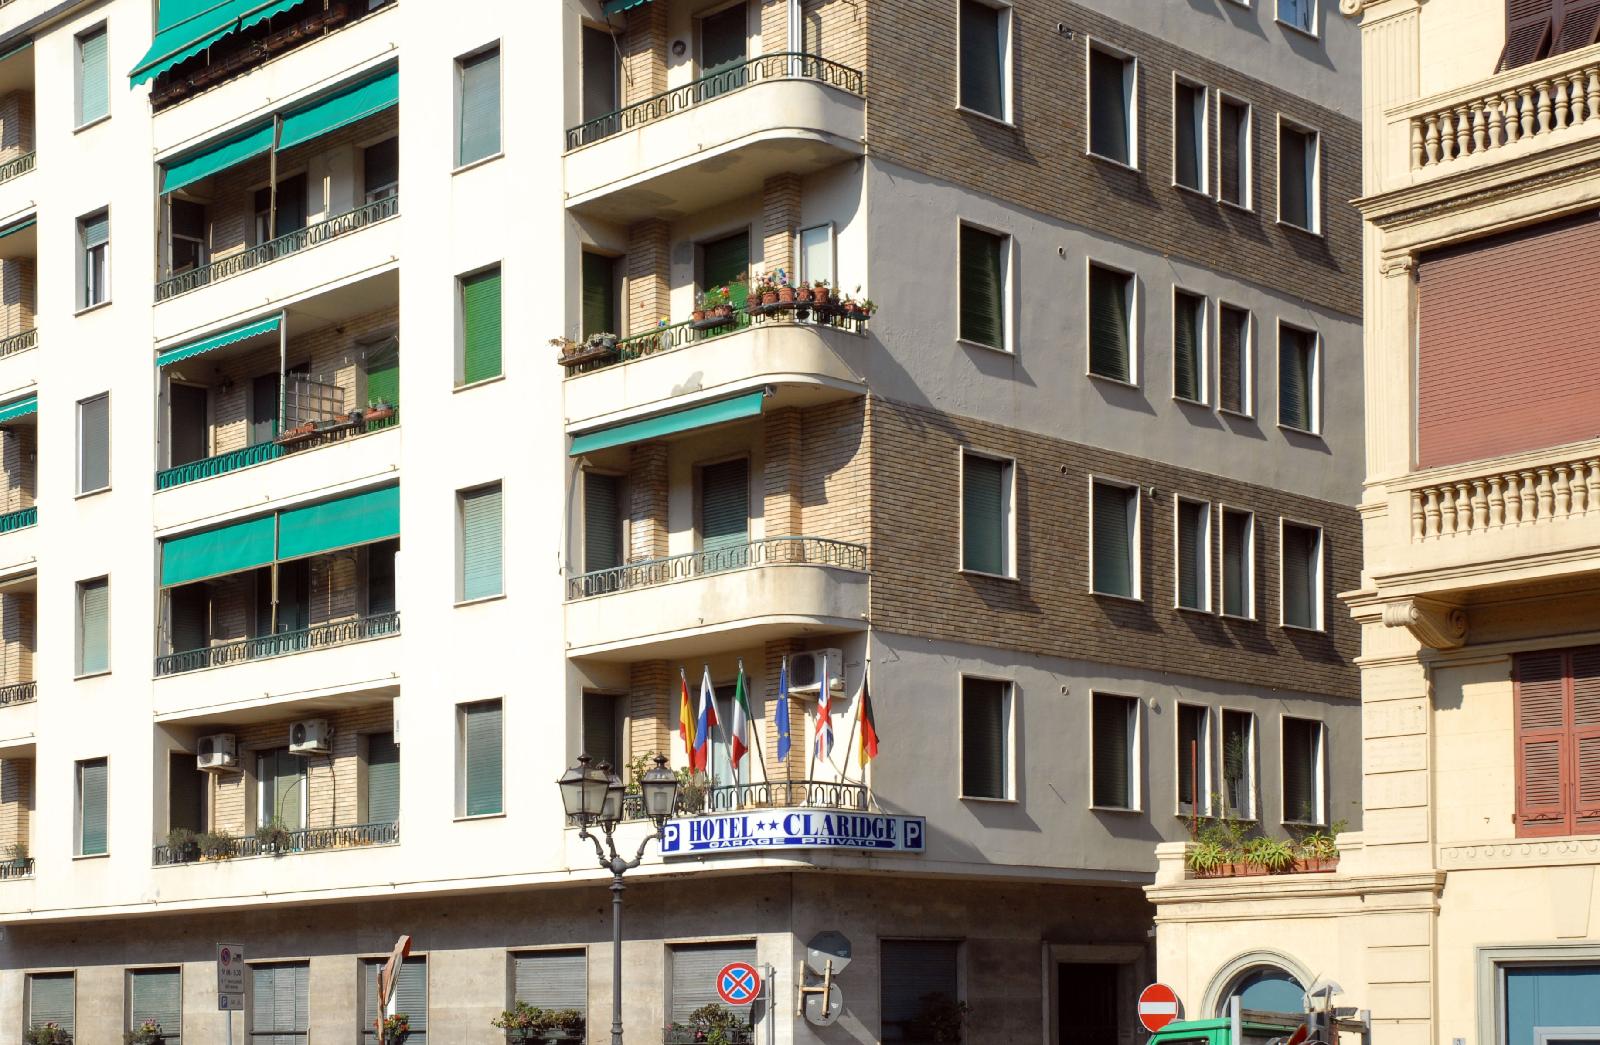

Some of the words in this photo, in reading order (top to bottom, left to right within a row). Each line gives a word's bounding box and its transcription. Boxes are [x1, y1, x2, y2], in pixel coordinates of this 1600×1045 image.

[664, 825, 678, 850] P
[688, 816, 754, 842] HOTEL
[782, 813, 896, 840] CLARIDGE
[906, 822, 920, 846] P
[709, 837, 785, 849] GARAGE
[801, 837, 876, 847] PRIVATO
